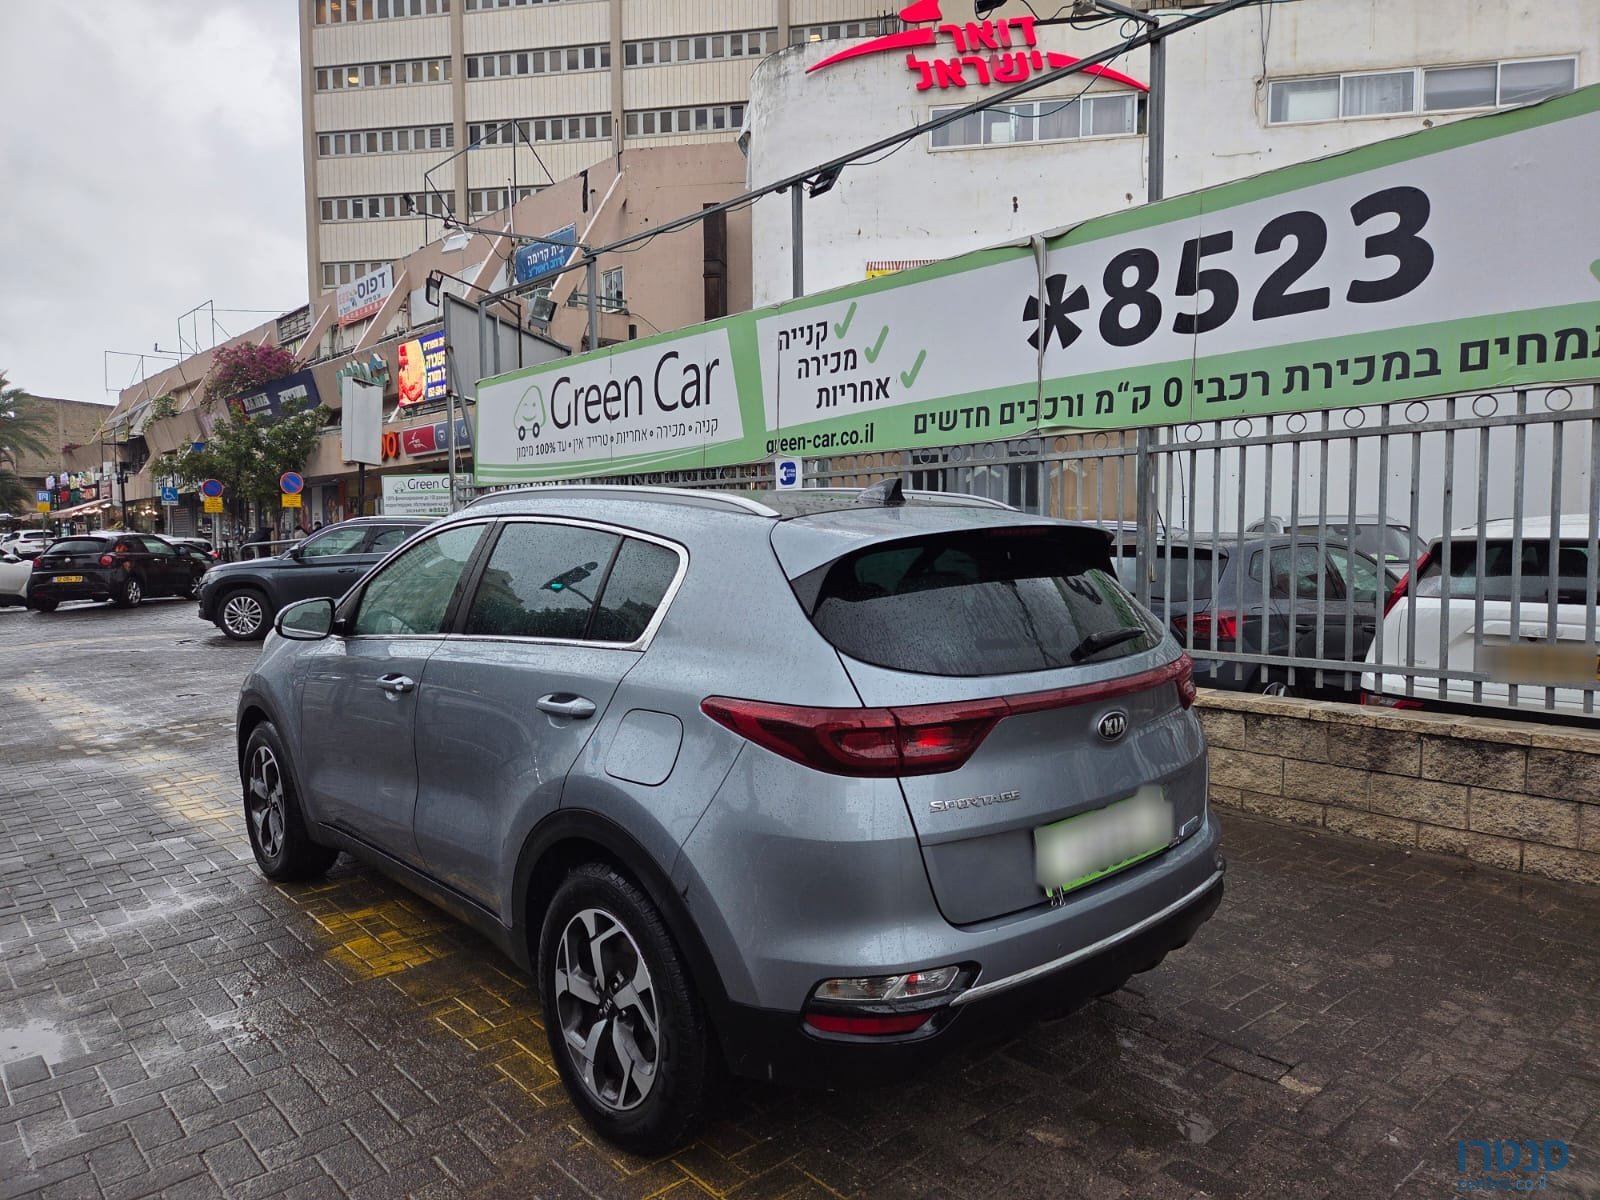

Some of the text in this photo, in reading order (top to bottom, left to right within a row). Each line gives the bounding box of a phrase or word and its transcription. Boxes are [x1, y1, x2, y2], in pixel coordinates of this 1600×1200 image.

[939, 16, 1037, 53] דואר
[906, 50, 1043, 92] ישראל
[527, 248, 549, 266] קדימה
[357, 271, 386, 299] דפוס
[778, 321, 828, 351] קנייה
[797, 348, 857, 379] מכירה
[1282, 347, 1441, 394] במכירת
[551, 351, 720, 430] Green Car
[816, 376, 891, 409] אחריות
[1164, 377, 1182, 407] 0
[1194, 370, 1270, 403] רכבי
[914, 405, 990, 434] חדשים
[1000, 393, 1083, 425] ורכבים
[516, 418, 718, 461] קניה מכירה אחריות טרייד אין עד 100% מימון
[766, 422, 874, 453] green-car.co.il
[407, 478, 439, 490] Green
[1104, 716, 1126, 736] KIA
[929, 790, 1021, 813] SPORTAGE
